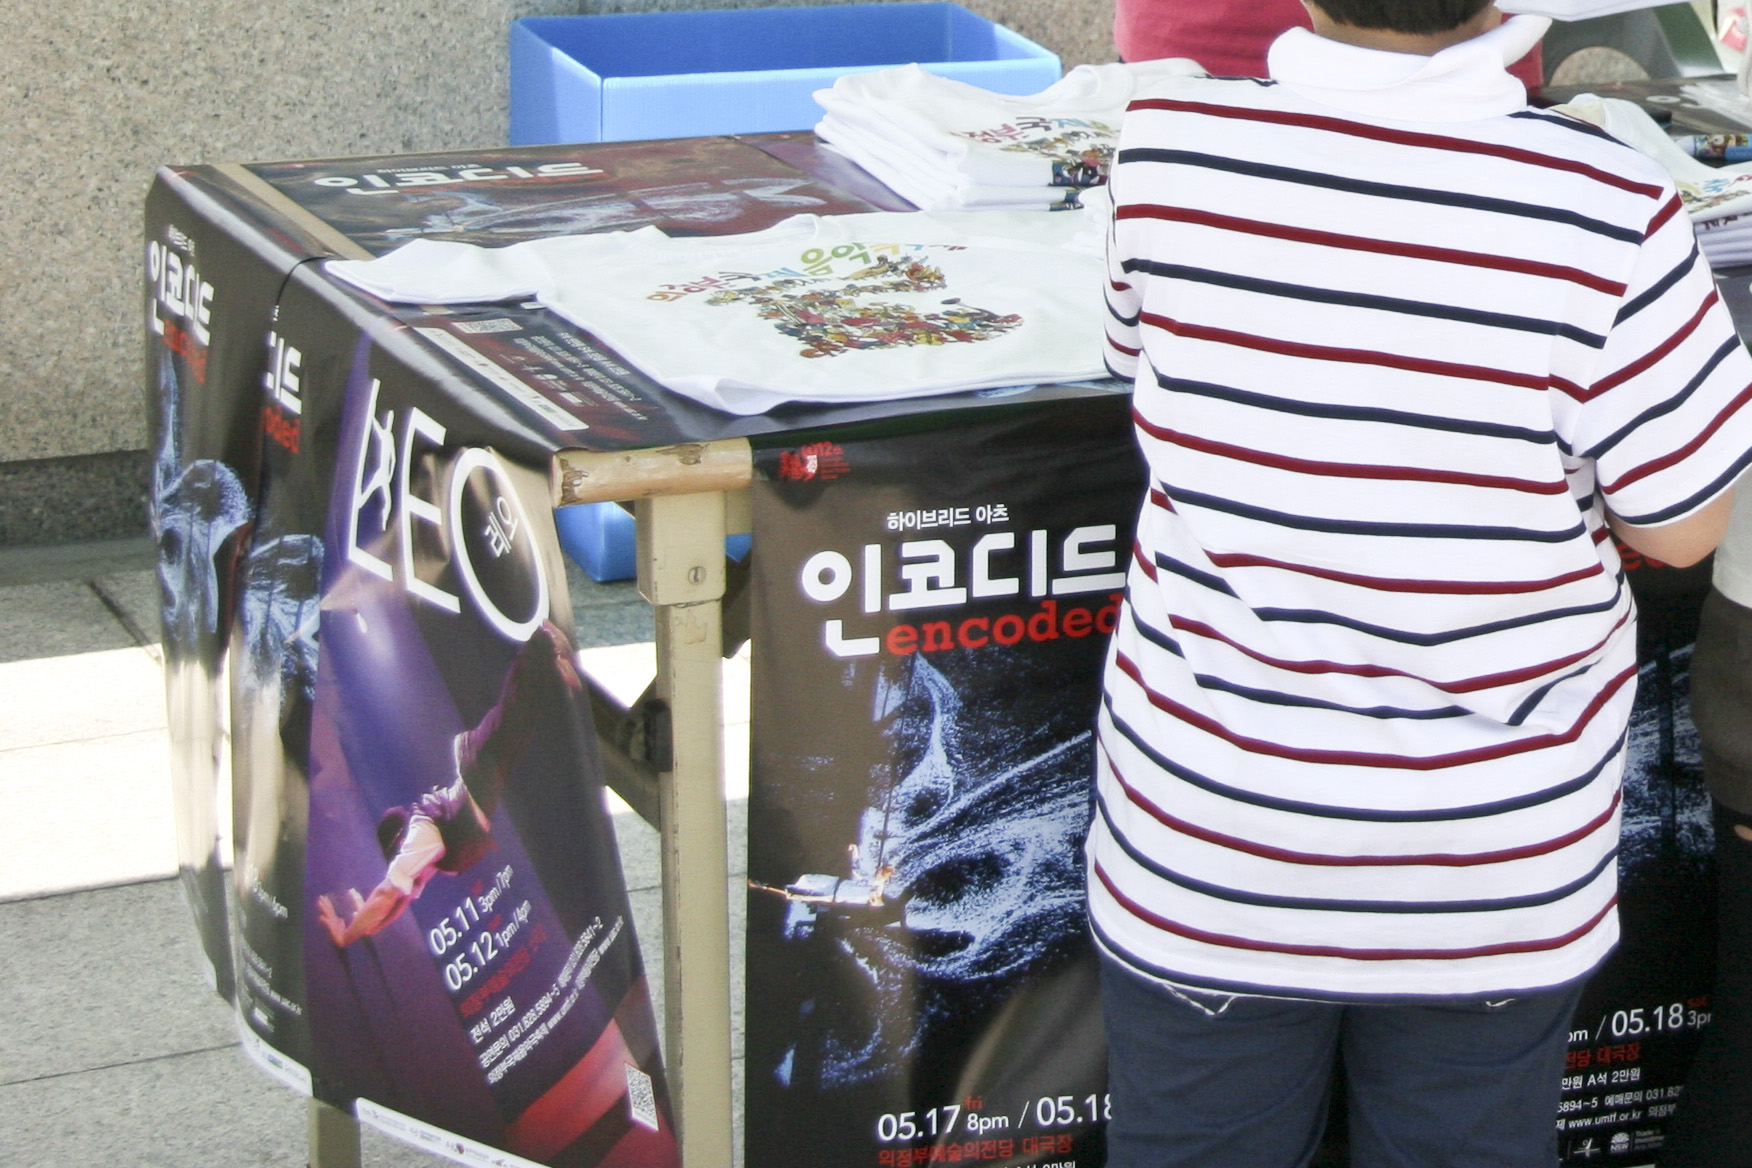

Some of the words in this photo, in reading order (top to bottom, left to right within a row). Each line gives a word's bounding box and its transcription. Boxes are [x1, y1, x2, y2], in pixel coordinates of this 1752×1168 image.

[314, 162, 604, 196] 인코디드
[149, 240, 214, 347] 인코디드
[348, 378, 551, 642] LEO
[485, 496, 518, 558] 레오
[886, 507, 972, 531] 하이브리드
[975, 504, 1009, 525] 아츠
[801, 524, 1127, 657] 인코디드
[886, 593, 1124, 656] encoded
[429, 896, 480, 955] 05.11
[445, 931, 499, 991] 05.12
[470, 1017, 492, 1044] 전석
[489, 996, 516, 1027] 2만원
[1611, 1002, 1684, 1037] 05.18
[1561, 1075, 1583, 1090] 만원
[1587, 1072, 1608, 1087] A석
[1612, 1067, 1641, 1083] 2만원
[1604, 1093, 1643, 1108] 예매문의
[1646, 1085, 1683, 1101] 031.82
[965, 1096, 984, 1110] fri
[1568, 1109, 1643, 1129] www.umtf.or.kr
[877, 1104, 961, 1141] 05.17
[967, 1113, 1010, 1135] 8pm
[878, 1137, 1016, 1167] 의정부예술의전당
[1022, 1134, 1075, 1156] 대극장
